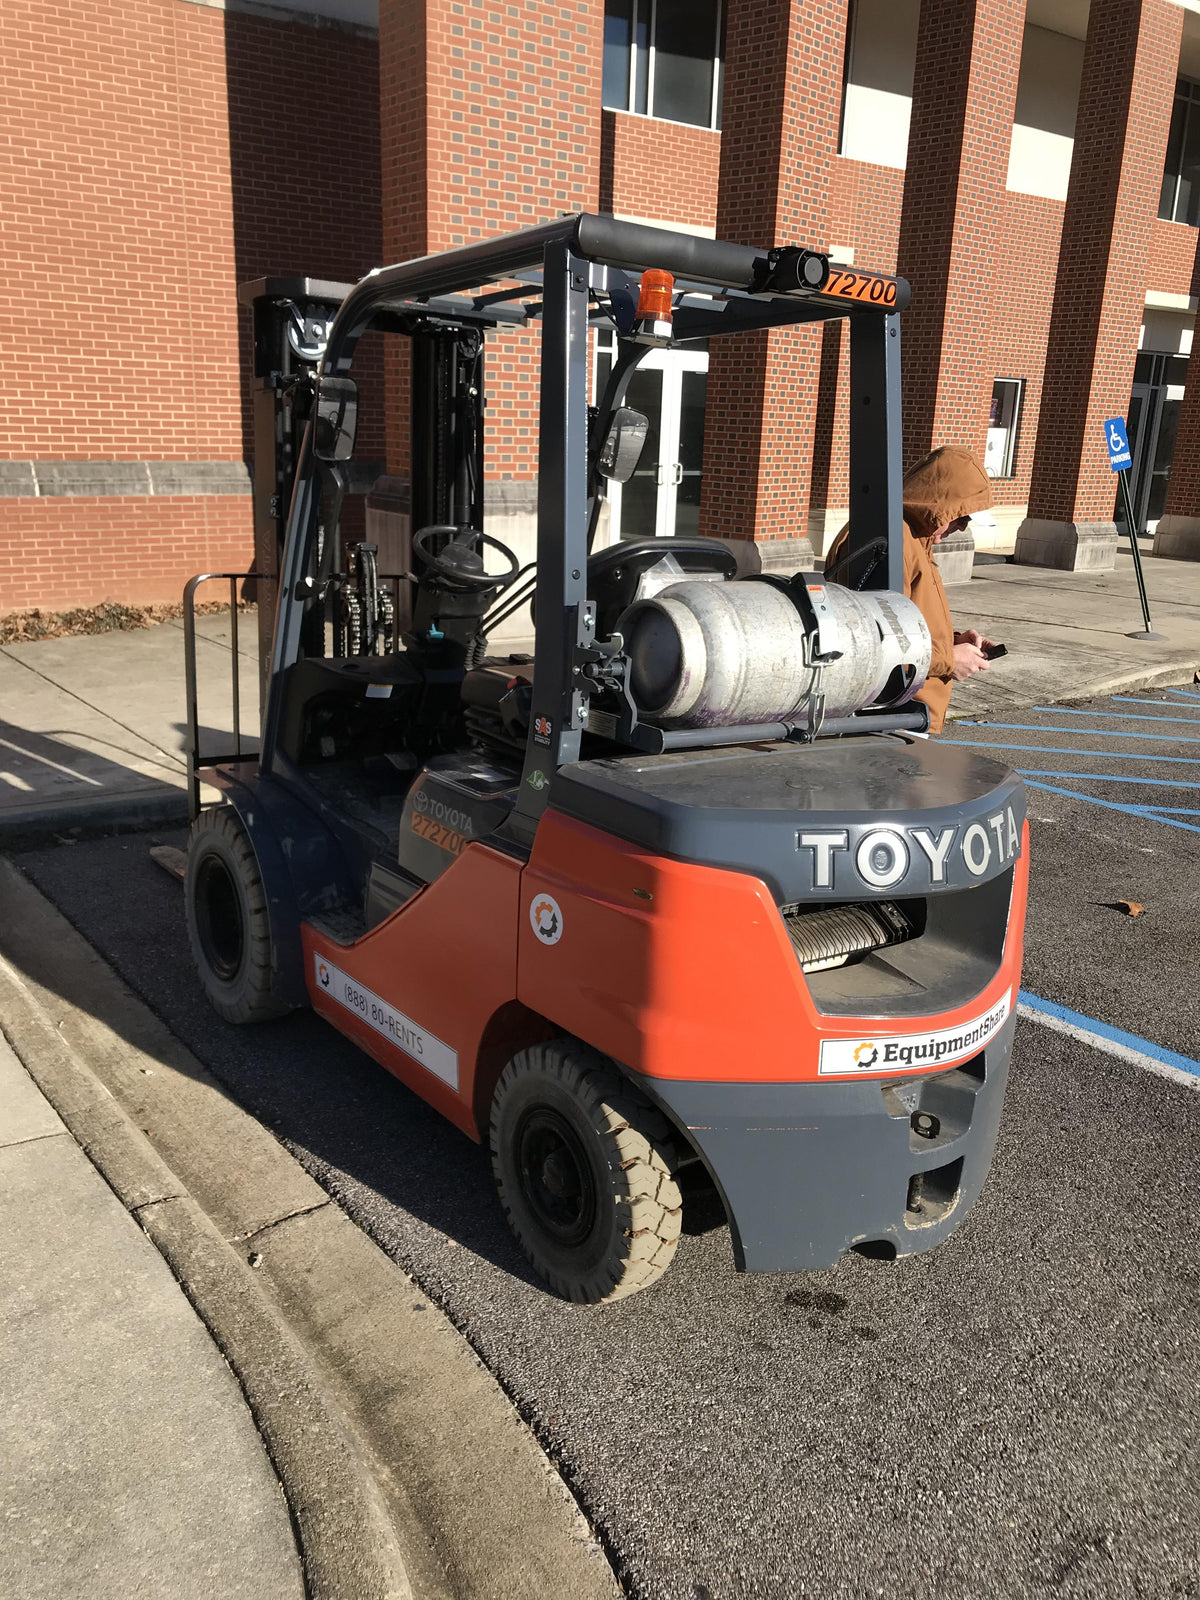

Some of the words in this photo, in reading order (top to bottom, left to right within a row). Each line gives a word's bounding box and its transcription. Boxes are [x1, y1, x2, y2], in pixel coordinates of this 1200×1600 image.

[1110, 451, 1131, 465] PARKING
[535, 717, 552, 736] SAS
[430, 799, 473, 834] TOYOTA
[798, 806, 1020, 888] TOYOTA
[344, 983, 369, 1016] (888)
[371, 1004, 424, 1055] 80-RENTS
[883, 1005, 1005, 1064] EquipmentShare
